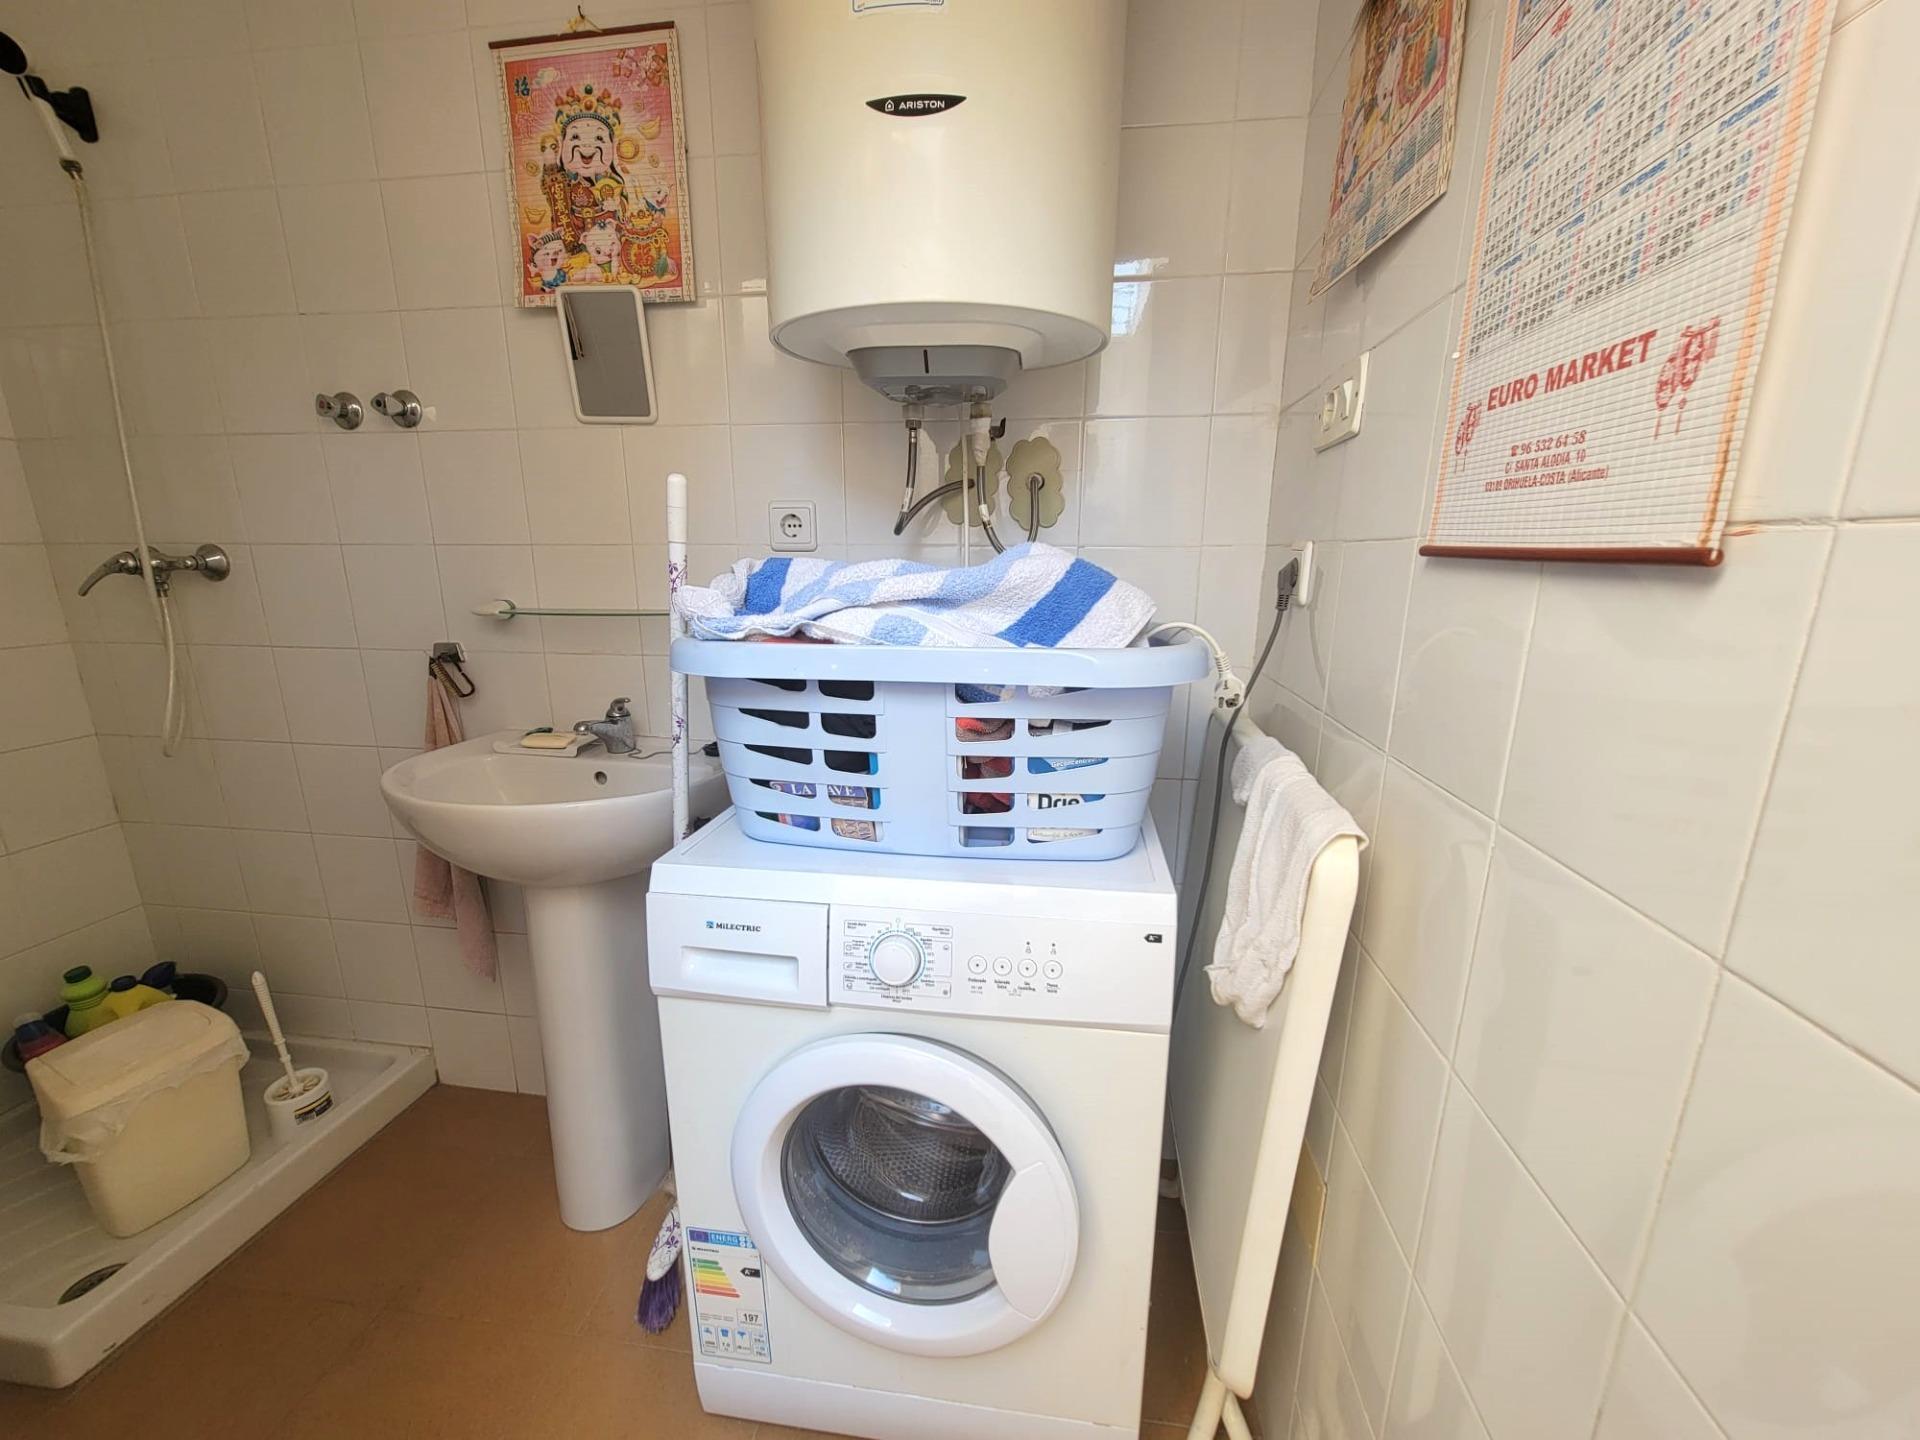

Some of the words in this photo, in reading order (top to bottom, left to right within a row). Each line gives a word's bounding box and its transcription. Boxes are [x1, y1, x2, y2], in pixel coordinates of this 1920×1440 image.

[899, 100, 945, 110] ARISTON
[1487, 374, 1539, 411] EURO
[1544, 329, 1657, 394] MARKET
[1520, 441, 1532, 455] 96
[1535, 438, 1553, 453] 532
[1571, 430, 1587, 445] 58
[1515, 457, 1538, 472] SANTA
[1504, 471, 1566, 490] ORIHUELA-COSTA
[1568, 464, 1610, 483] (Alicante)
[743, 1313, 759, 1323] 197
